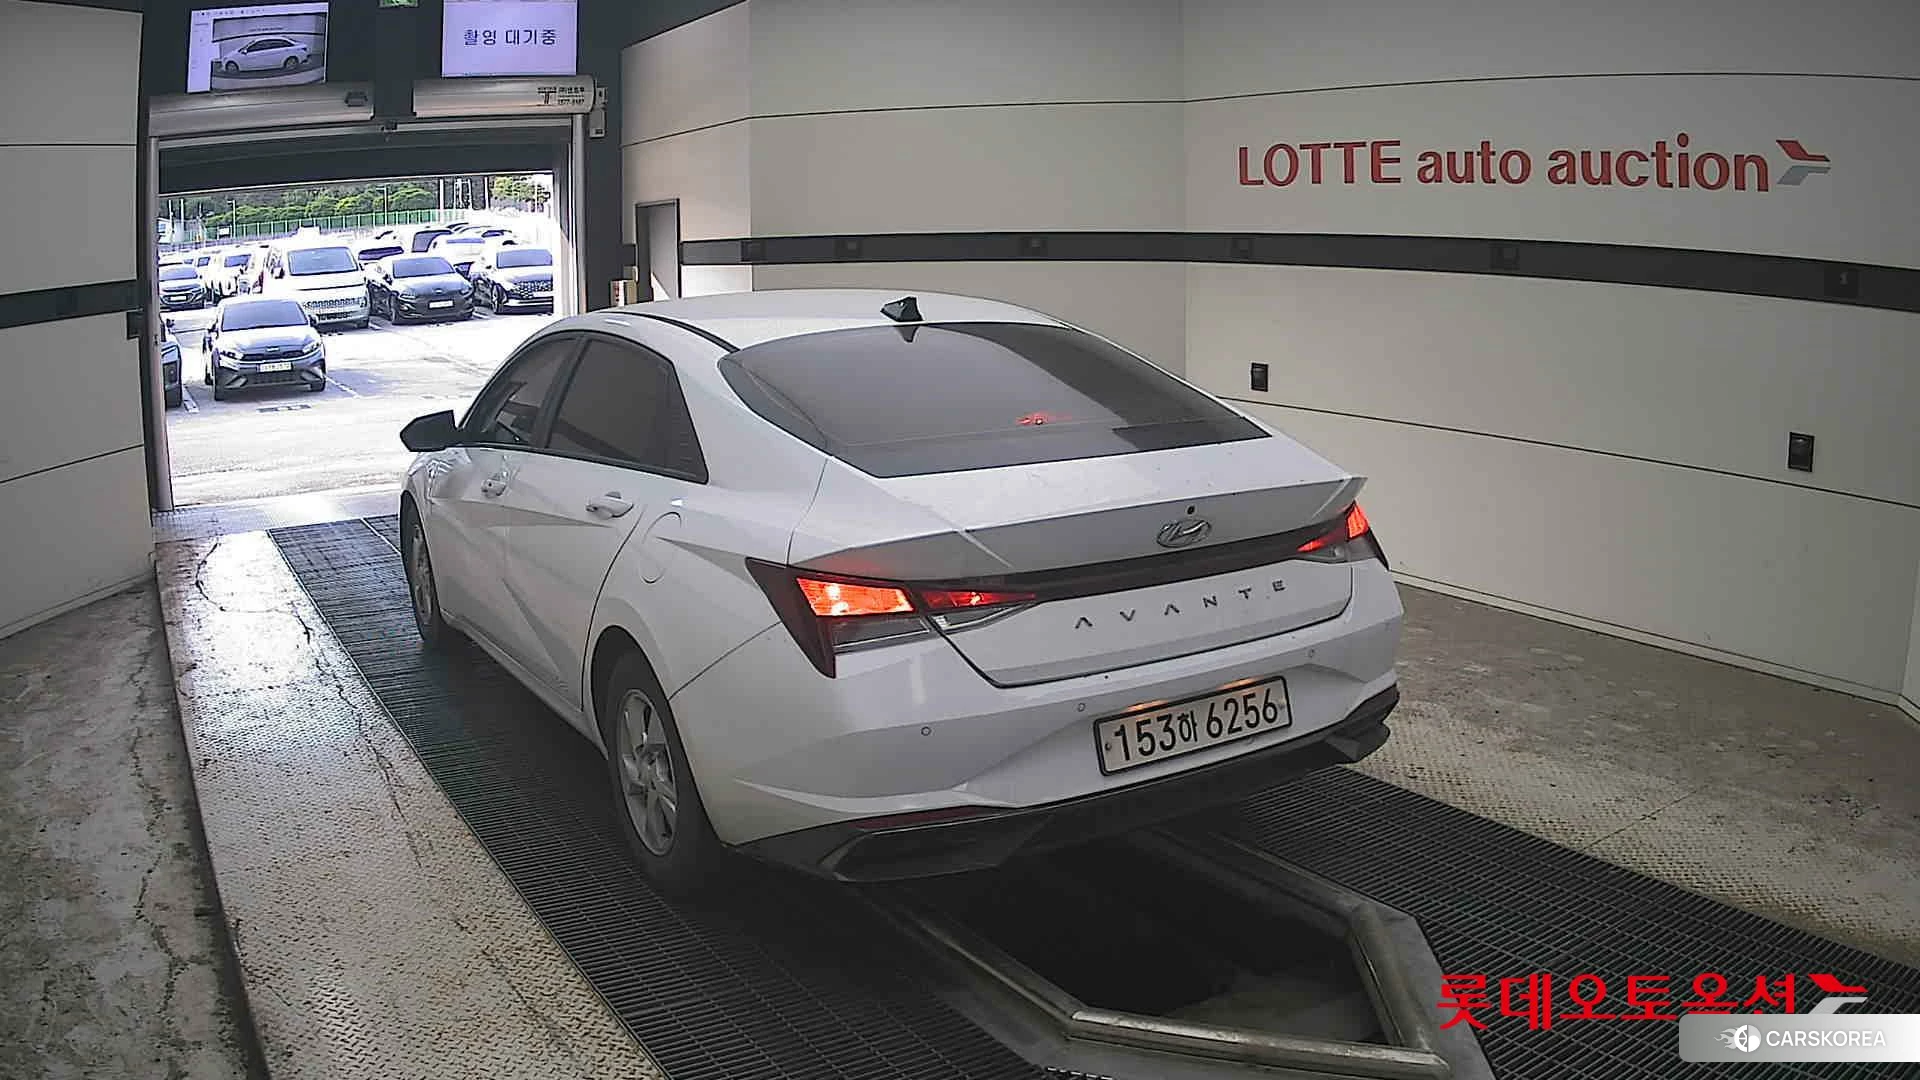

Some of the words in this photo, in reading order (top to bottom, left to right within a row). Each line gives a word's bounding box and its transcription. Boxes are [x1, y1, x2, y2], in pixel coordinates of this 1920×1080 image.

[463, 28, 497, 46] 촬영
[505, 28, 557, 46] 대기중
[1238, 140, 1402, 187] LOTTE
[1416, 140, 1532, 185] auto
[1547, 132, 1769, 192] auction
[1074, 579, 1287, 630] AVANTE
[1114, 710, 1198, 761] 153하
[1206, 687, 1279, 739] 6256
